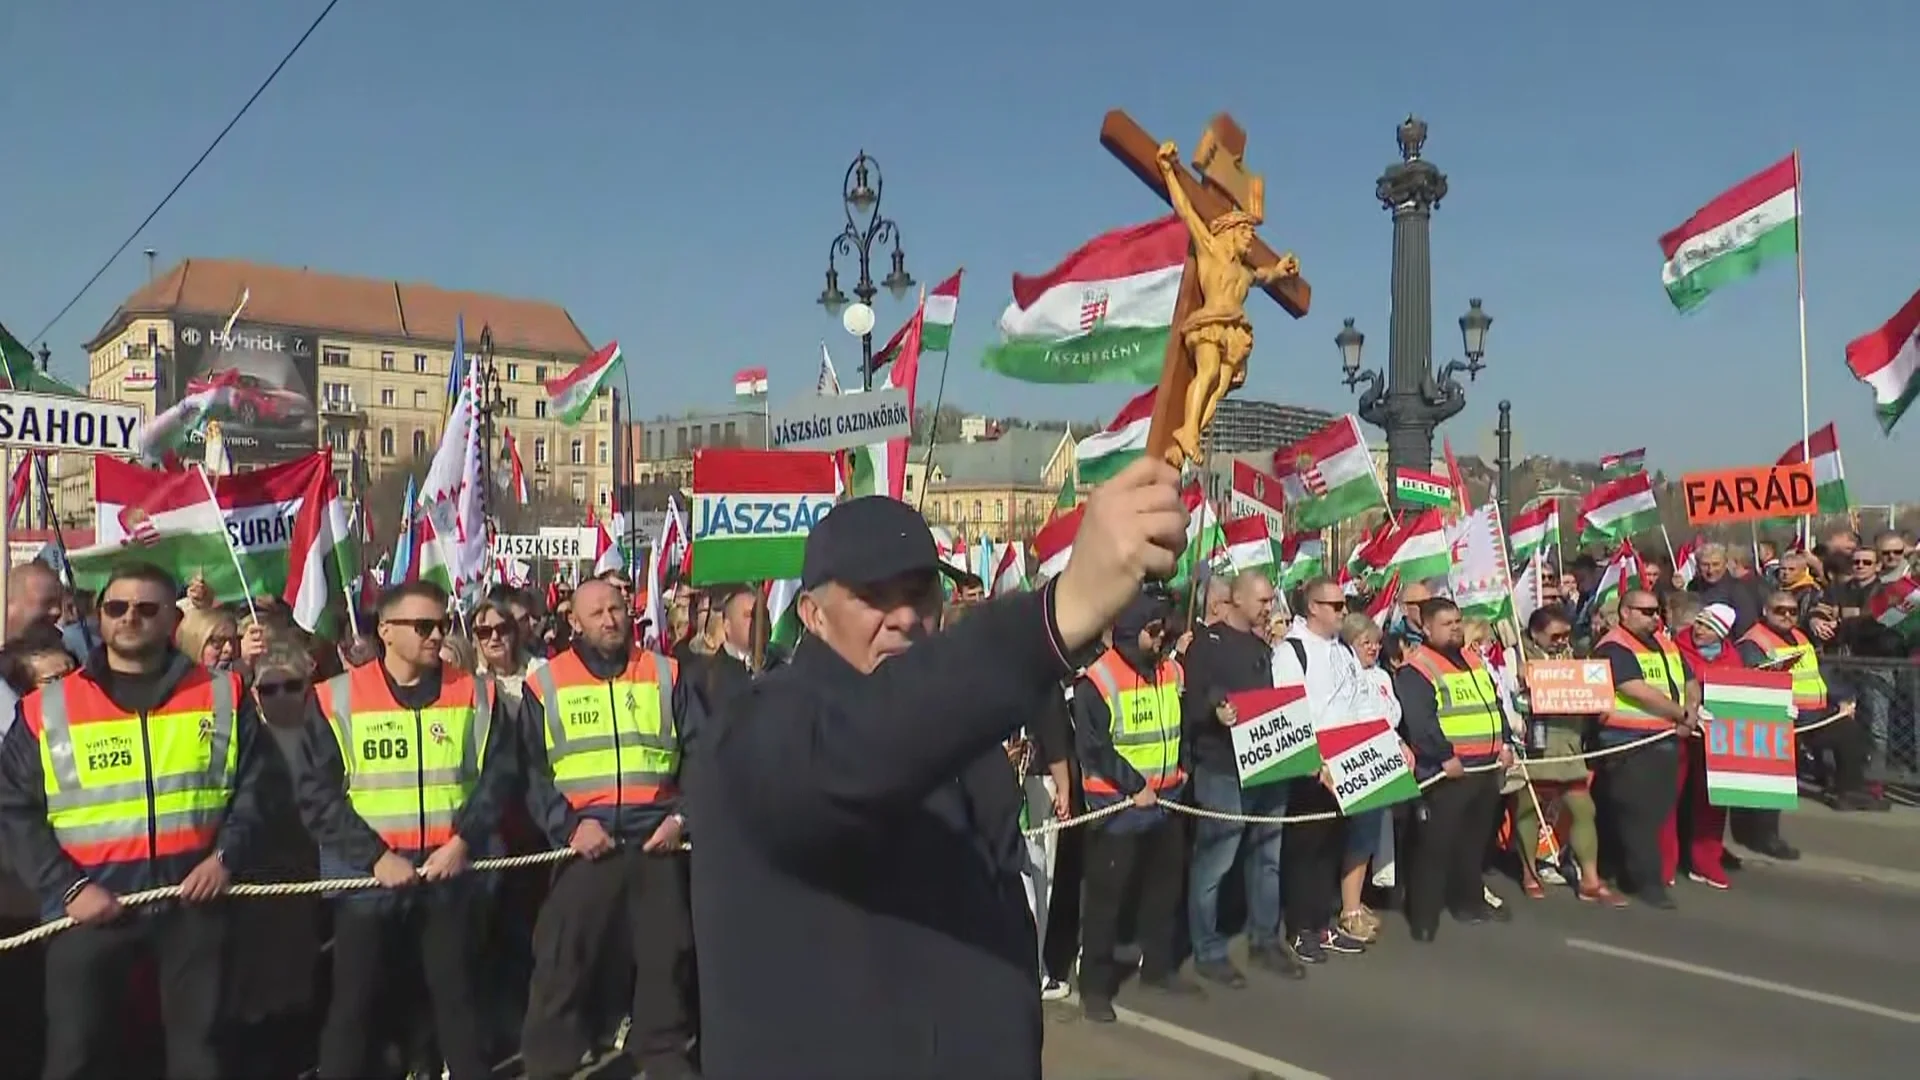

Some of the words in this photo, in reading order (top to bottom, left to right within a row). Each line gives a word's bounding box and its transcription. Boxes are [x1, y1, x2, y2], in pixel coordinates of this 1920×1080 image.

[210, 330, 286, 352] Hybrid+
[0, 403, 137, 449] SAHOLY
[774, 413, 832, 445] JÁSZSÁGI
[1686, 467, 1814, 516] FARÁD
[496, 534, 580, 556] JÁSZKISÉR
[570, 711, 599, 725] E102
[1249, 711, 1292, 745] HAJRÁ,
[363, 738, 408, 760] 603
[1275, 722, 1314, 754] JÁNOS!
[89, 750, 132, 771] E325
[1340, 742, 1383, 775] HAJRÁ,
